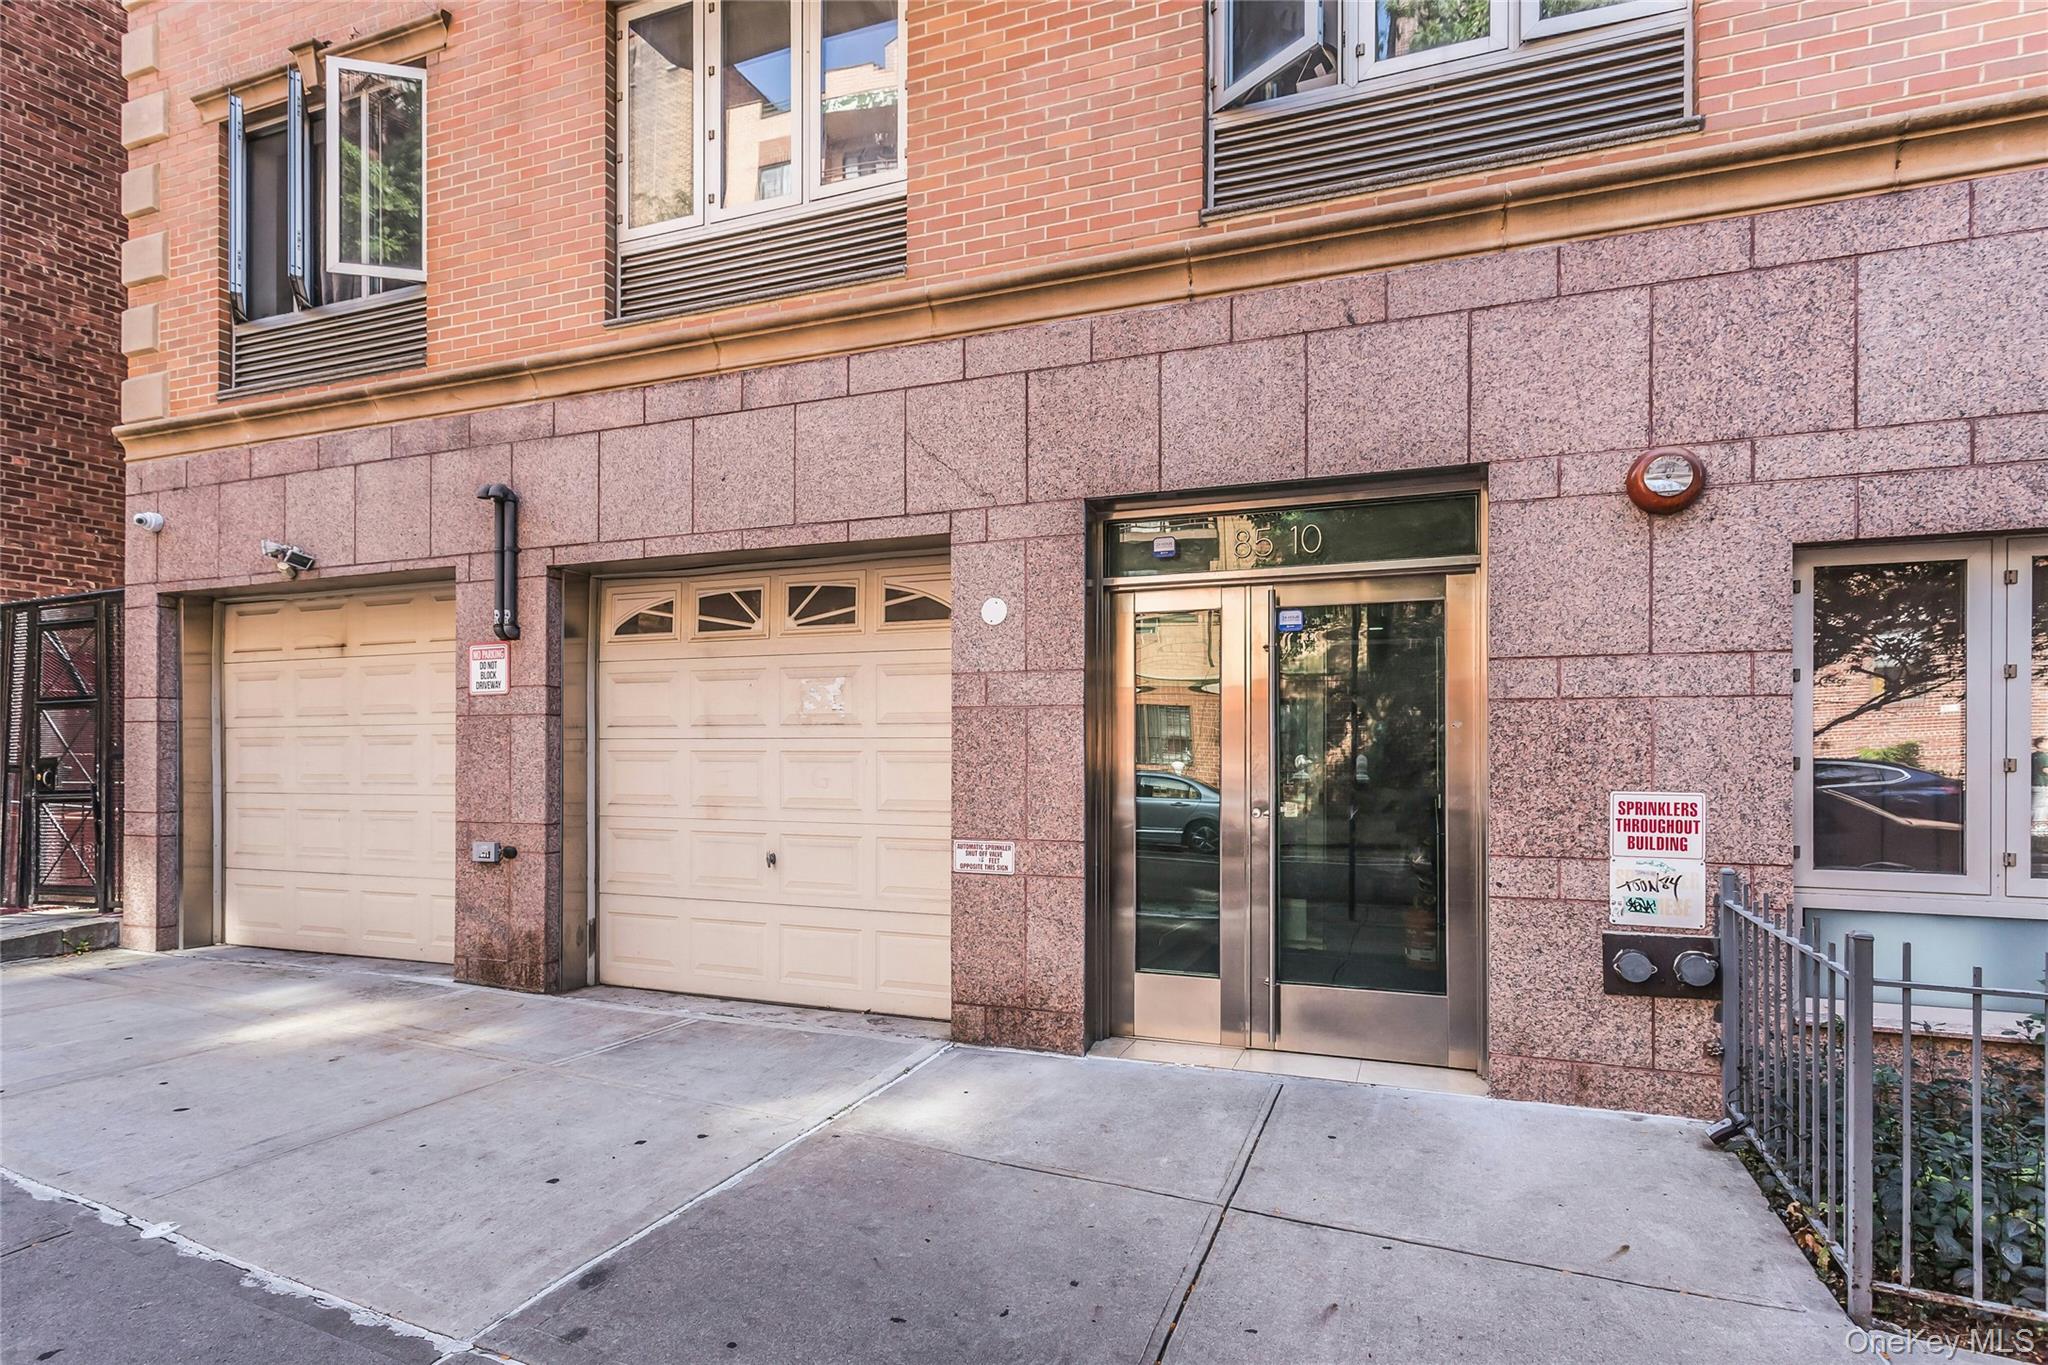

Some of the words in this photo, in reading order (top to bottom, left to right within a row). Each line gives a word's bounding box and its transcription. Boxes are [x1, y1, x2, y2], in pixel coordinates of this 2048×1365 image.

[472, 650, 481, 660] NO
[482, 648, 505, 660] PARKING
[480, 661, 486, 669] DO
[488, 661, 497, 669] NOT
[480, 671, 496, 679] BLOCK
[476, 681, 501, 689] DRIVEWAY
[1618, 801, 1698, 817] SPRINKLERS
[1615, 818, 1700, 834] THROUGHOUT
[1627, 836, 1688, 852] BUILDING
